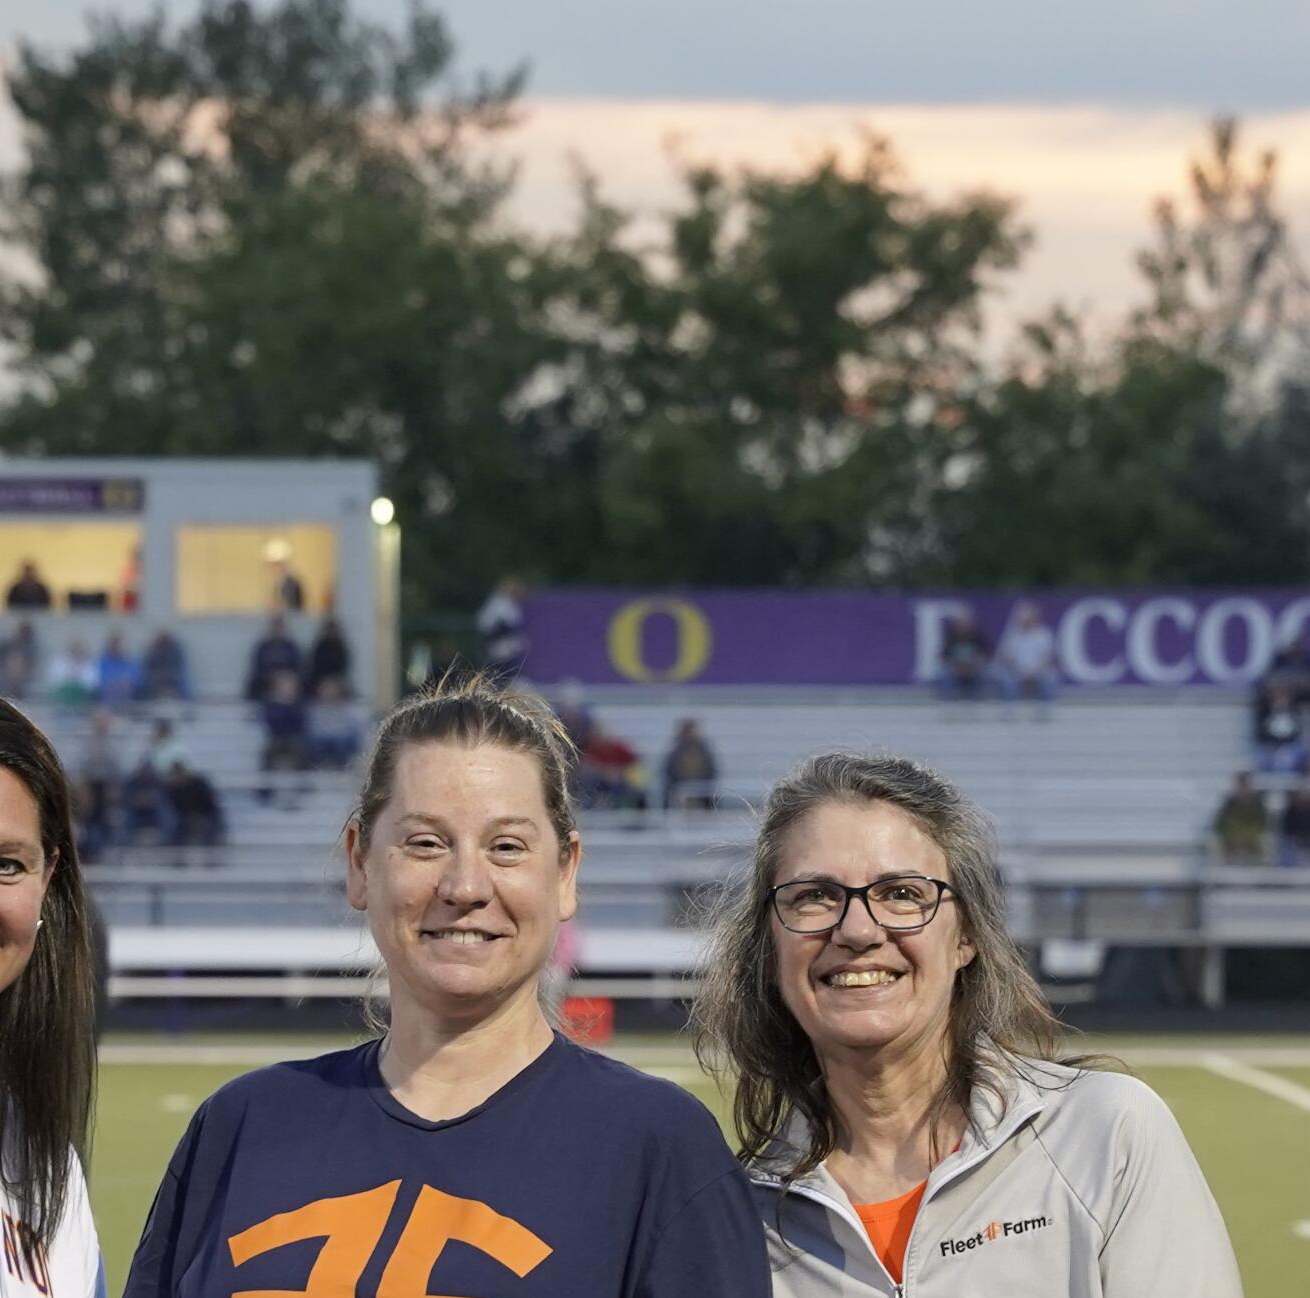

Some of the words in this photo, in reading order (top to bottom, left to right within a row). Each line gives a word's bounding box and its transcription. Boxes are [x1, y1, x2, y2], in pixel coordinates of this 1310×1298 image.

[606, 593, 715, 688] O
[939, 1232, 984, 1257] Fleet
[1002, 1215, 1047, 1237] Farm
